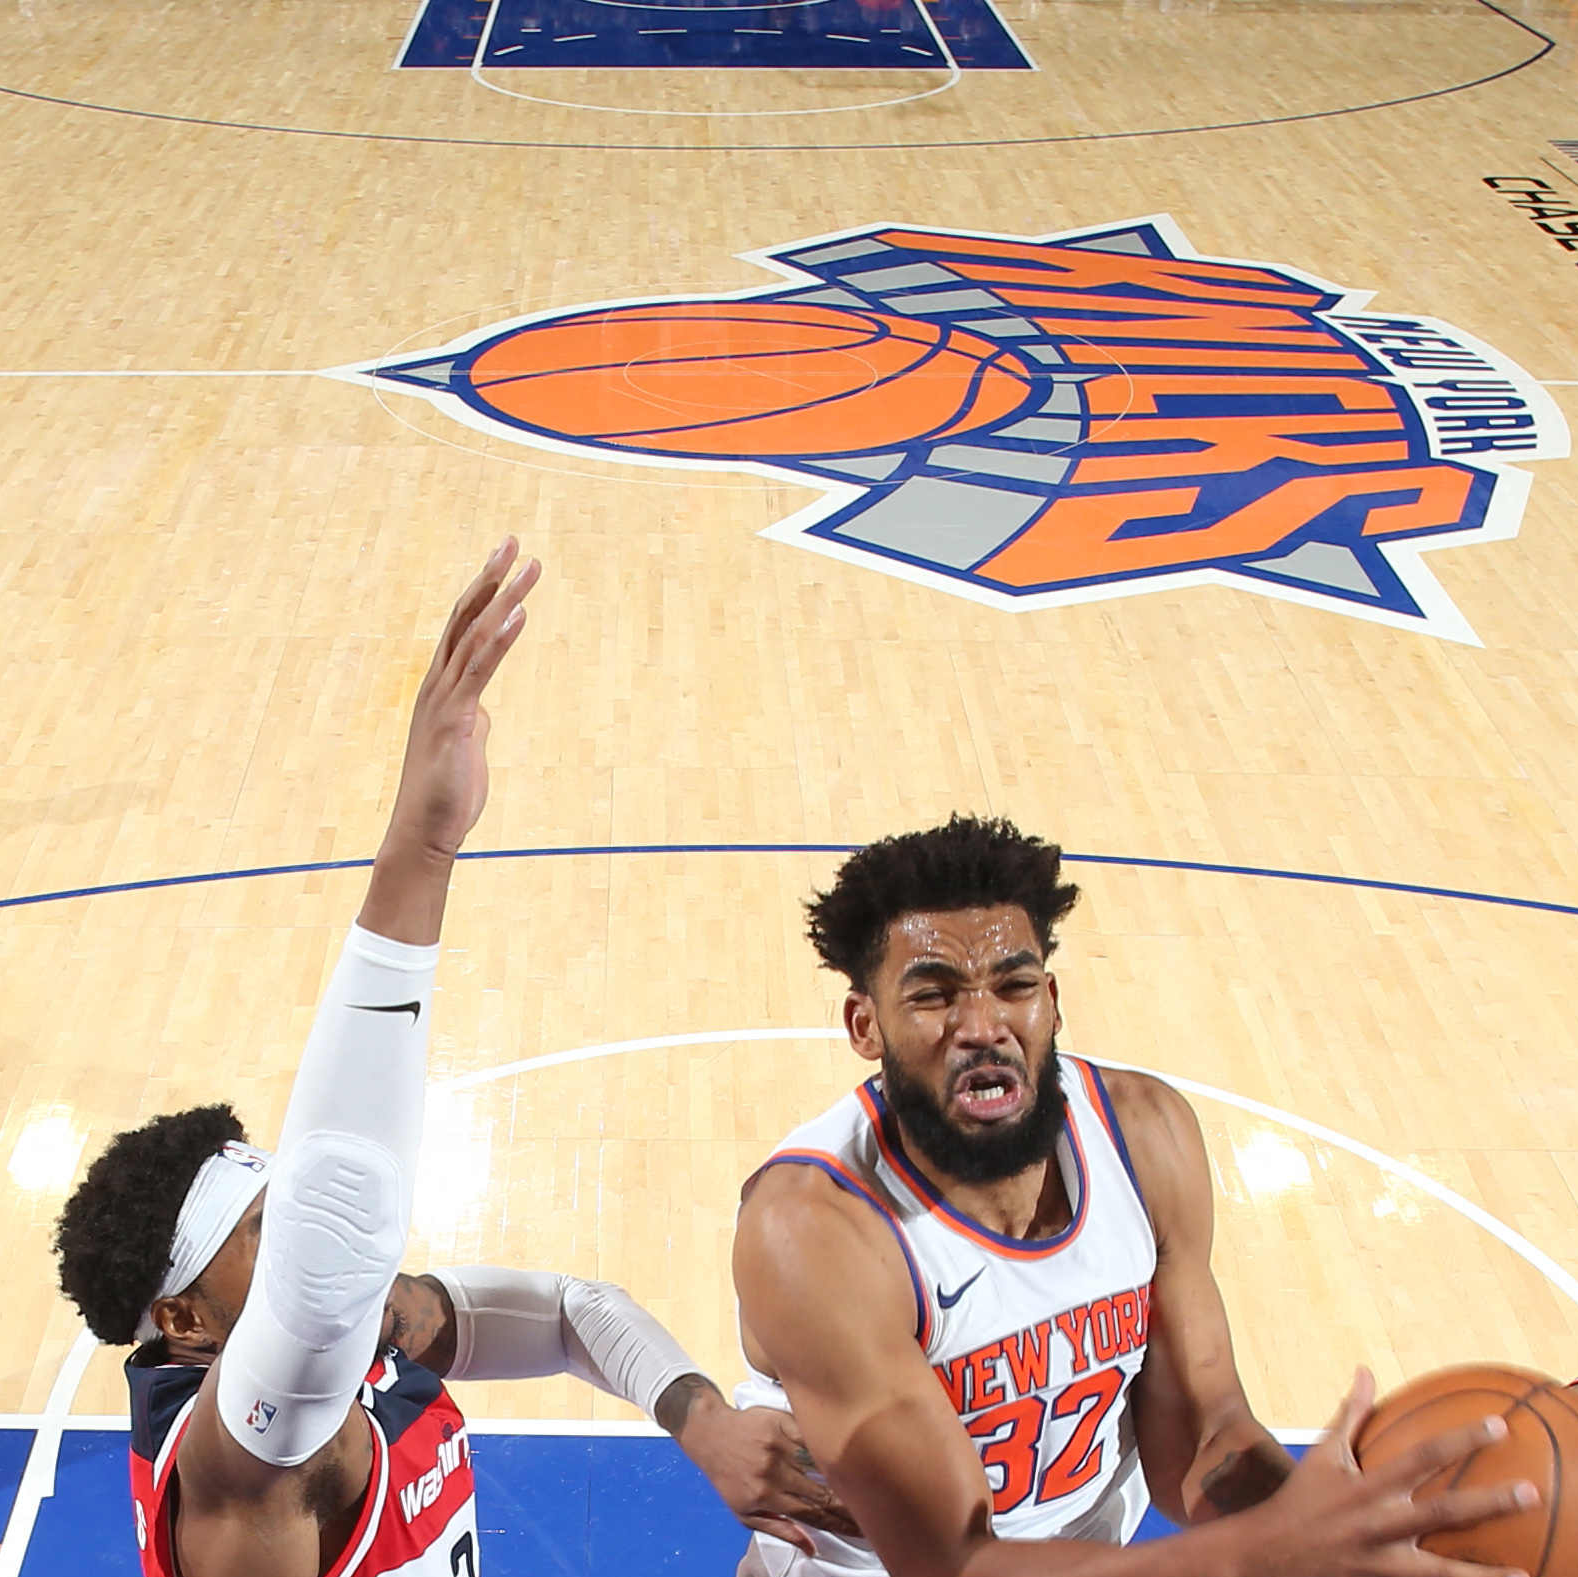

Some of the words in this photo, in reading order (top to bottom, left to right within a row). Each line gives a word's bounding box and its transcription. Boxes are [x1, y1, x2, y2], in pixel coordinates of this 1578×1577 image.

[873, 228, 1481, 592] KNICKS
[1326, 315, 1498, 370] NEW
[1412, 380, 1538, 455] YORK
[933, 1326, 1055, 1413] NEW
[965, 1366, 1126, 1515] 32
